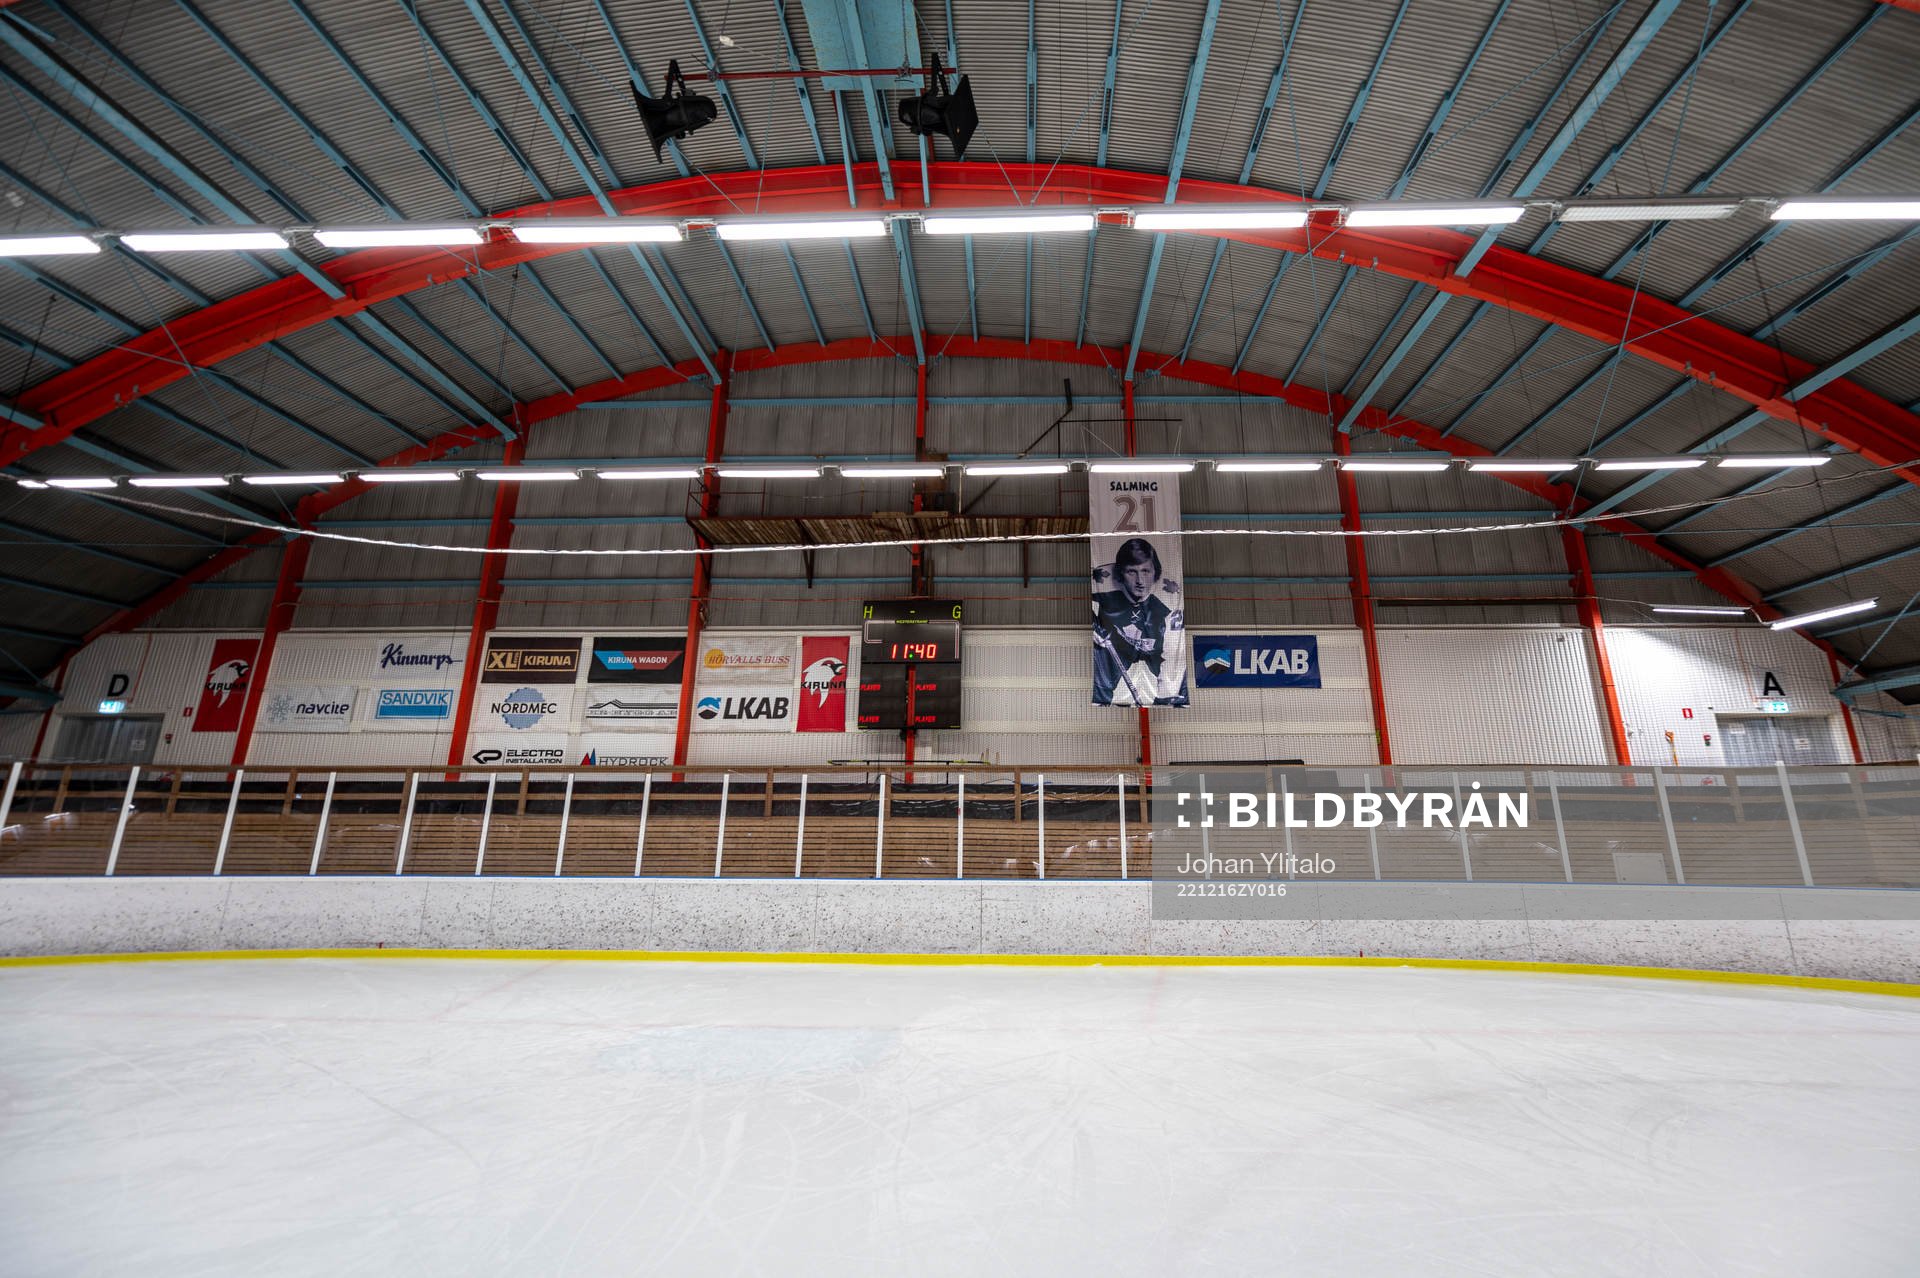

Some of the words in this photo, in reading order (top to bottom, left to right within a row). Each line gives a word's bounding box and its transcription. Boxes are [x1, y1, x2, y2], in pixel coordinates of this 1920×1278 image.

[1110, 481, 1158, 492] SALMING
[1112, 495, 1157, 532] 21
[863, 605, 873, 619] H
[952, 605, 961, 619] G
[380, 643, 463, 669] Kinnarps
[891, 643, 937, 659] 11:40
[488, 651, 518, 669] XL
[523, 655, 572, 666] KIRUNA
[608, 656, 638, 664] KIRUNA
[639, 656, 668, 664] WAGON
[764, 655, 791, 664] BUSS
[1234, 649, 1310, 675] LKAB
[107, 674, 129, 697] D
[801, 681, 846, 690] KIRUNA
[1763, 671, 1786, 696] A
[382, 692, 449, 705] SANDVIK
[295, 701, 350, 715] navcite
[491, 702, 557, 714] NORDMEC
[723, 697, 789, 720] LKAB
[599, 756, 668, 767] HYDROCK
